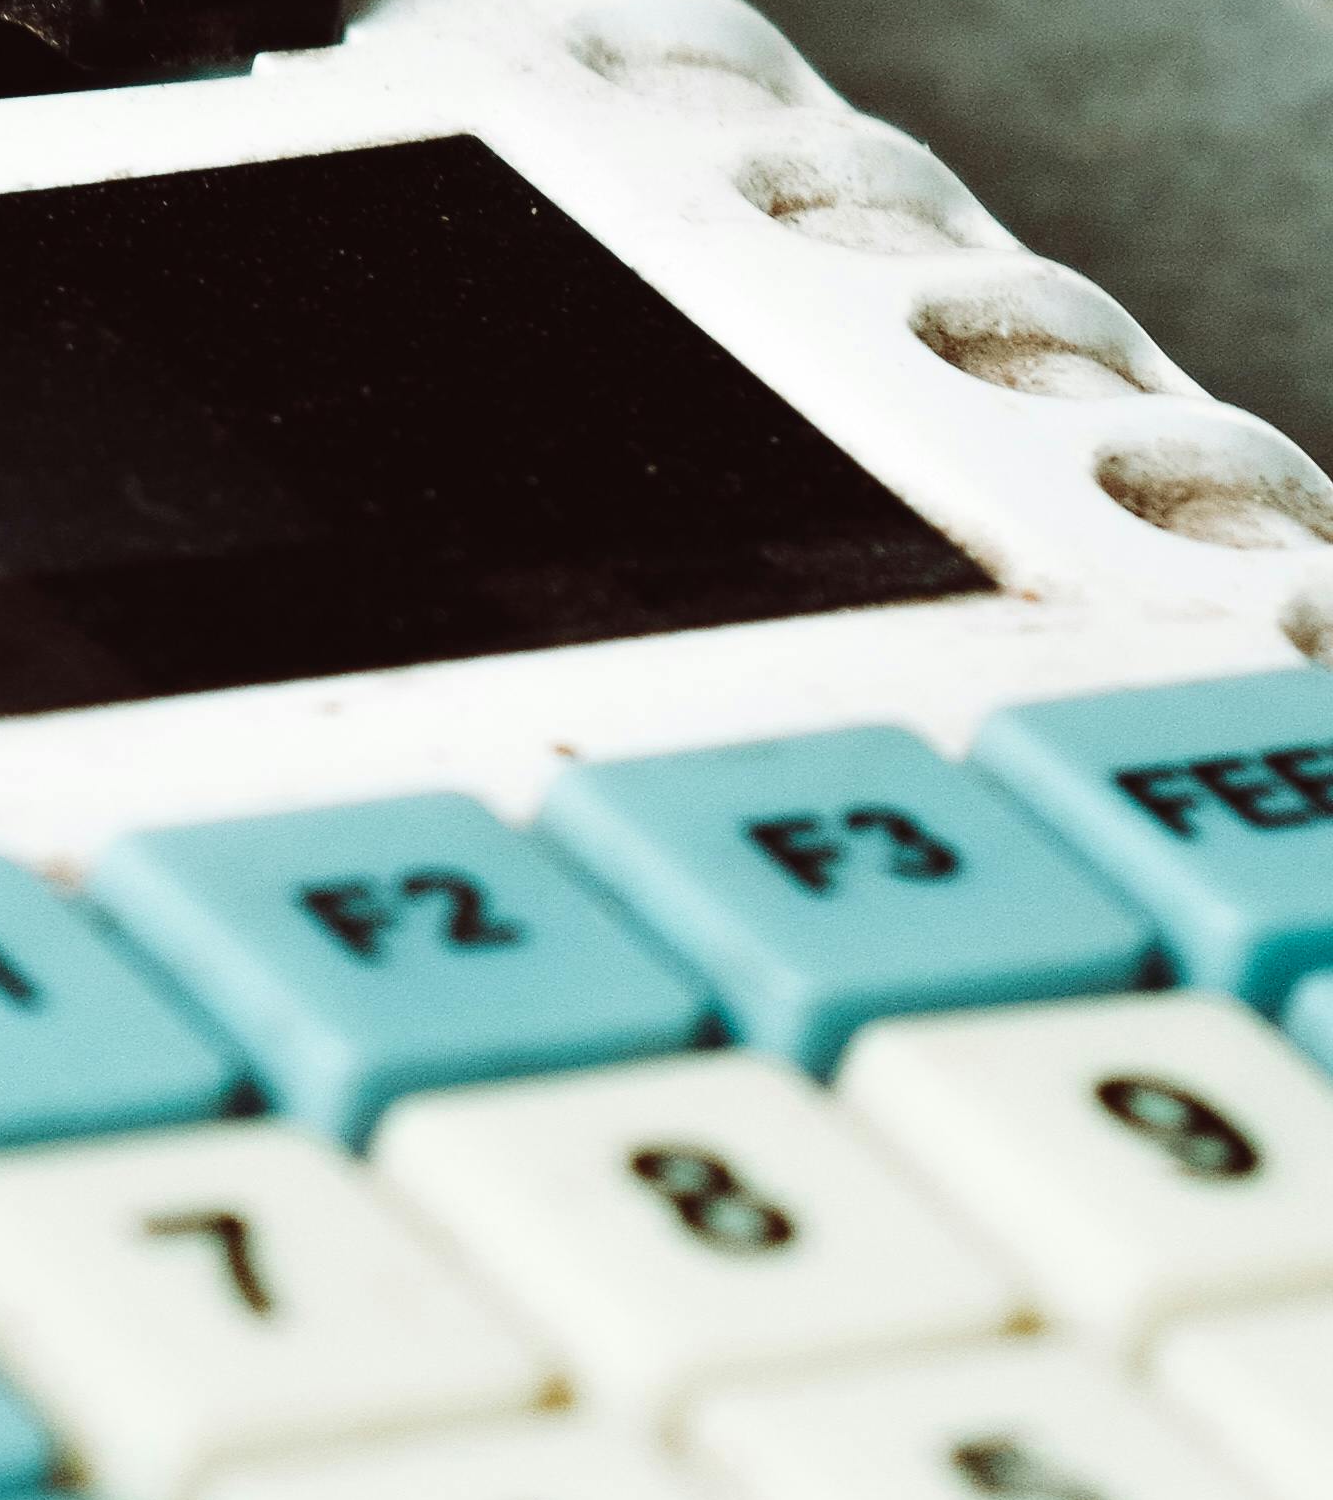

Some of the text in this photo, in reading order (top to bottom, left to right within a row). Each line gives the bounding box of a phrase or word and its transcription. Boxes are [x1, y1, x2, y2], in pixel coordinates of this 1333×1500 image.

[746, 807, 961, 895] F3
[299, 871, 517, 959] F2
[1092, 1073, 1266, 1185] 9
[626, 1144, 800, 1255] 8
[148, 1209, 275, 1318] 7
